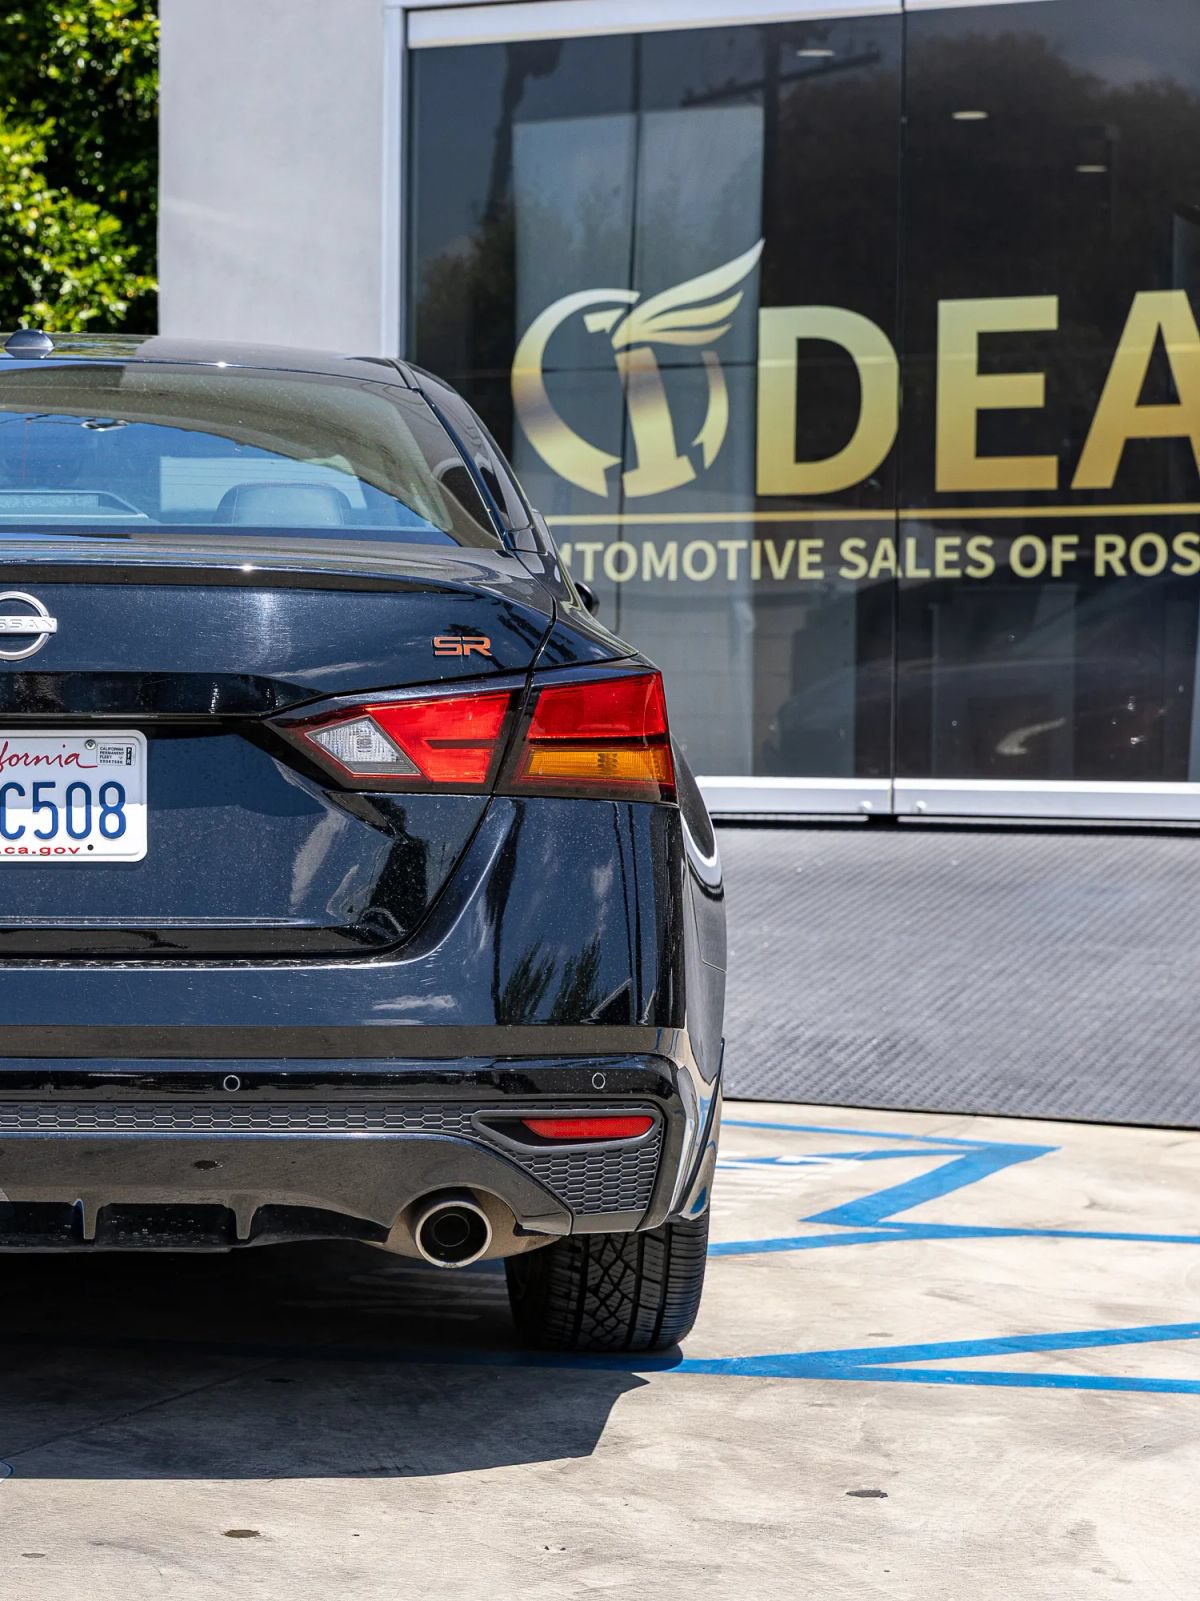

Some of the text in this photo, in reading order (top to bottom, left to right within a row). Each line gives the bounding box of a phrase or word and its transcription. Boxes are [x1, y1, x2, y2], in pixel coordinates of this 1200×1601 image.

[839, 535, 996, 580] SALES
[1008, 534, 1079, 578] OF
[1094, 532, 1200, 577] ROS
[432, 636, 492, 656] SR
